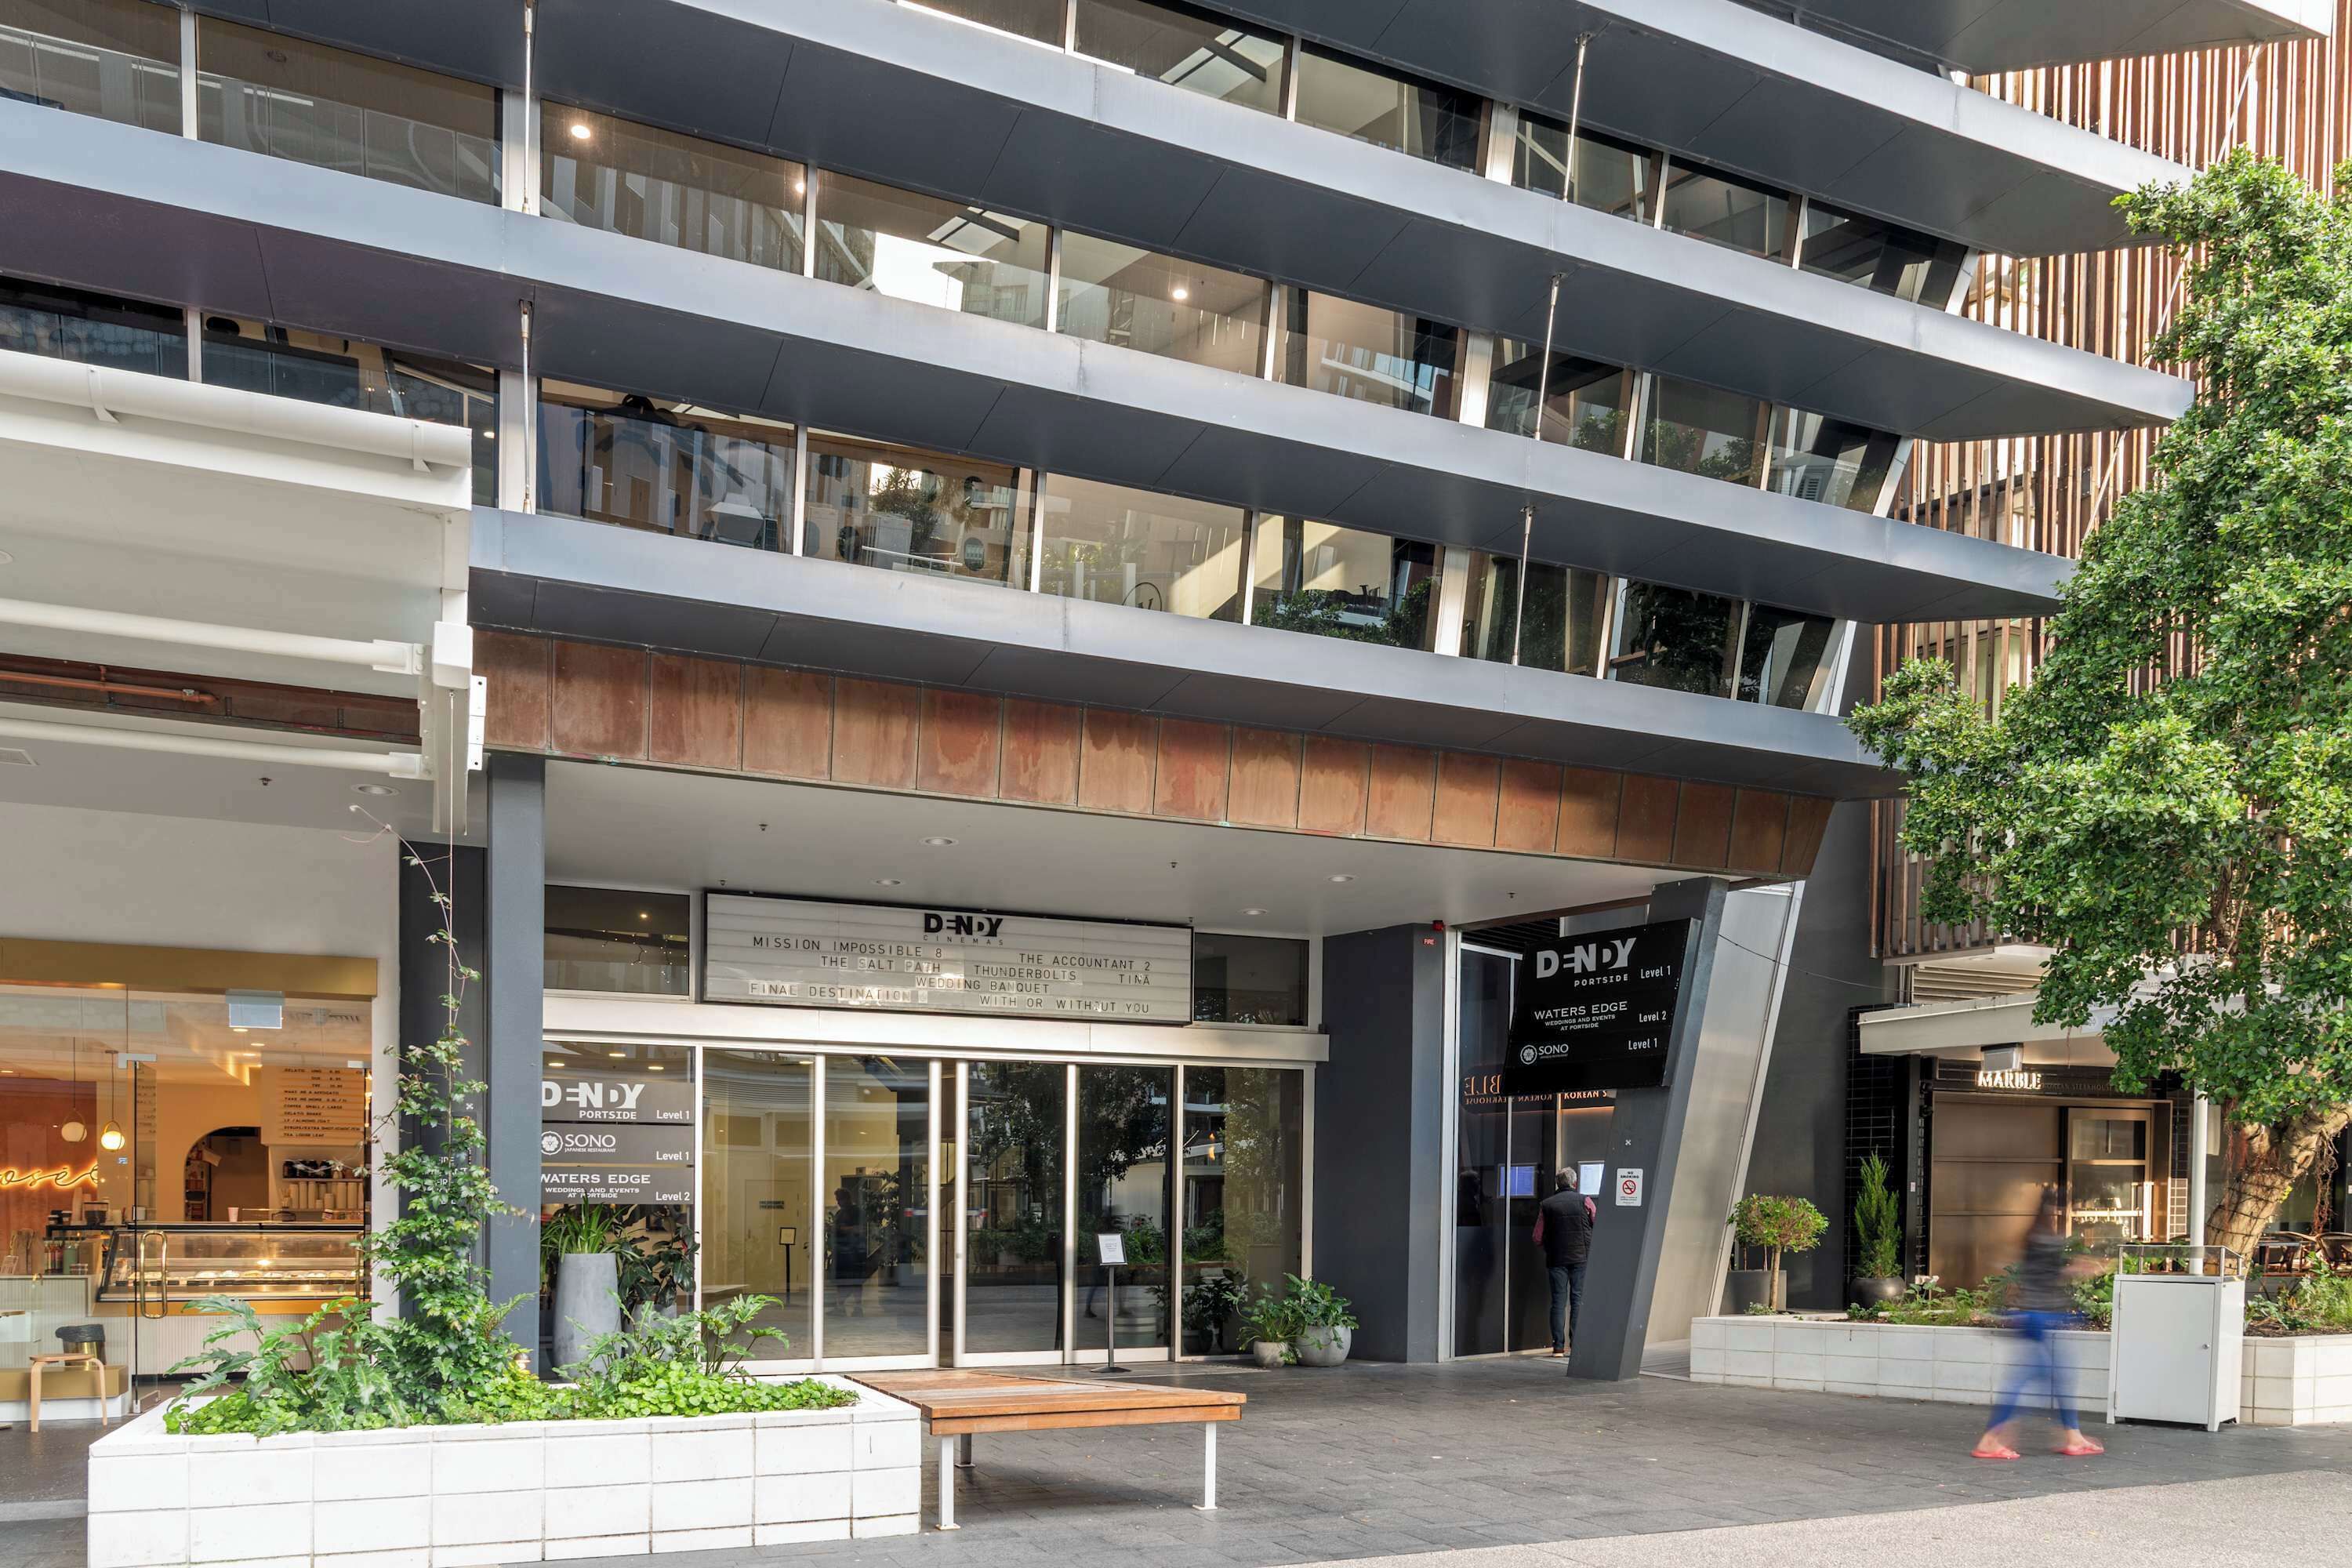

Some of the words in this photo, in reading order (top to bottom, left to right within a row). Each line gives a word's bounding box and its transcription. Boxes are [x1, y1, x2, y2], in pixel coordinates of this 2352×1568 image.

[924, 913, 1004, 937] DENDY
[753, 936, 821, 951] MISSION
[833, 941, 922, 956] IMPOSSIBLE
[935, 948, 942, 957] 8
[924, 935, 1004, 946] CINEMAS
[822, 956, 848, 968] THE
[858, 958, 894, 971] SALT
[906, 961, 941, 973] PATH
[1019, 953, 1044, 965] THE
[1052, 956, 1134, 971] ACCOUNTANT
[1145, 962, 1150, 971] 2
[1537, 938, 1636, 978] DENDY
[975, 965, 1076, 981] THUNDERBOLTS
[1120, 974, 1150, 985] TINA
[1574, 974, 1628, 987] PORTSIDE
[1640, 967, 1663, 979] Level
[1667, 966, 1671, 975] 1
[751, 983, 797, 996] FINAL
[809, 986, 910, 1001] DESTINATION
[916, 978, 980, 990] WEDDING
[990, 982, 1049, 993] BANQUET
[980, 996, 1017, 1007] WITH
[1027, 998, 1043, 1008] OR
[1057, 1000, 1116, 1012] WITHOUT
[1126, 1004, 1149, 1014] YOU
[1534, 1006, 1586, 1020] WATERS
[1592, 1001, 1628, 1014] EDGE
[1639, 1012, 1660, 1023] Level
[1662, 1011, 1667, 1020] 2
[1538, 1044, 1569, 1055] SONO
[1628, 1039, 1650, 1050] Level
[1653, 1038, 1657, 1047] 1
[1977, 1070, 2042, 1090] MARBLE
[542, 1081, 646, 1109] DENDY
[579, 1110, 637, 1120] PORTSIDE
[656, 1110, 682, 1120] Level
[686, 1110, 690, 1120] 1
[564, 1134, 616, 1148] SONO
[656, 1152, 682, 1160] Level
[685, 1152, 689, 1160] 1
[541, 1174, 601, 1183] WATERS
[608, 1174, 651, 1184] EDGE
[655, 1192, 682, 1201] Level
[684, 1192, 691, 1201] 2
